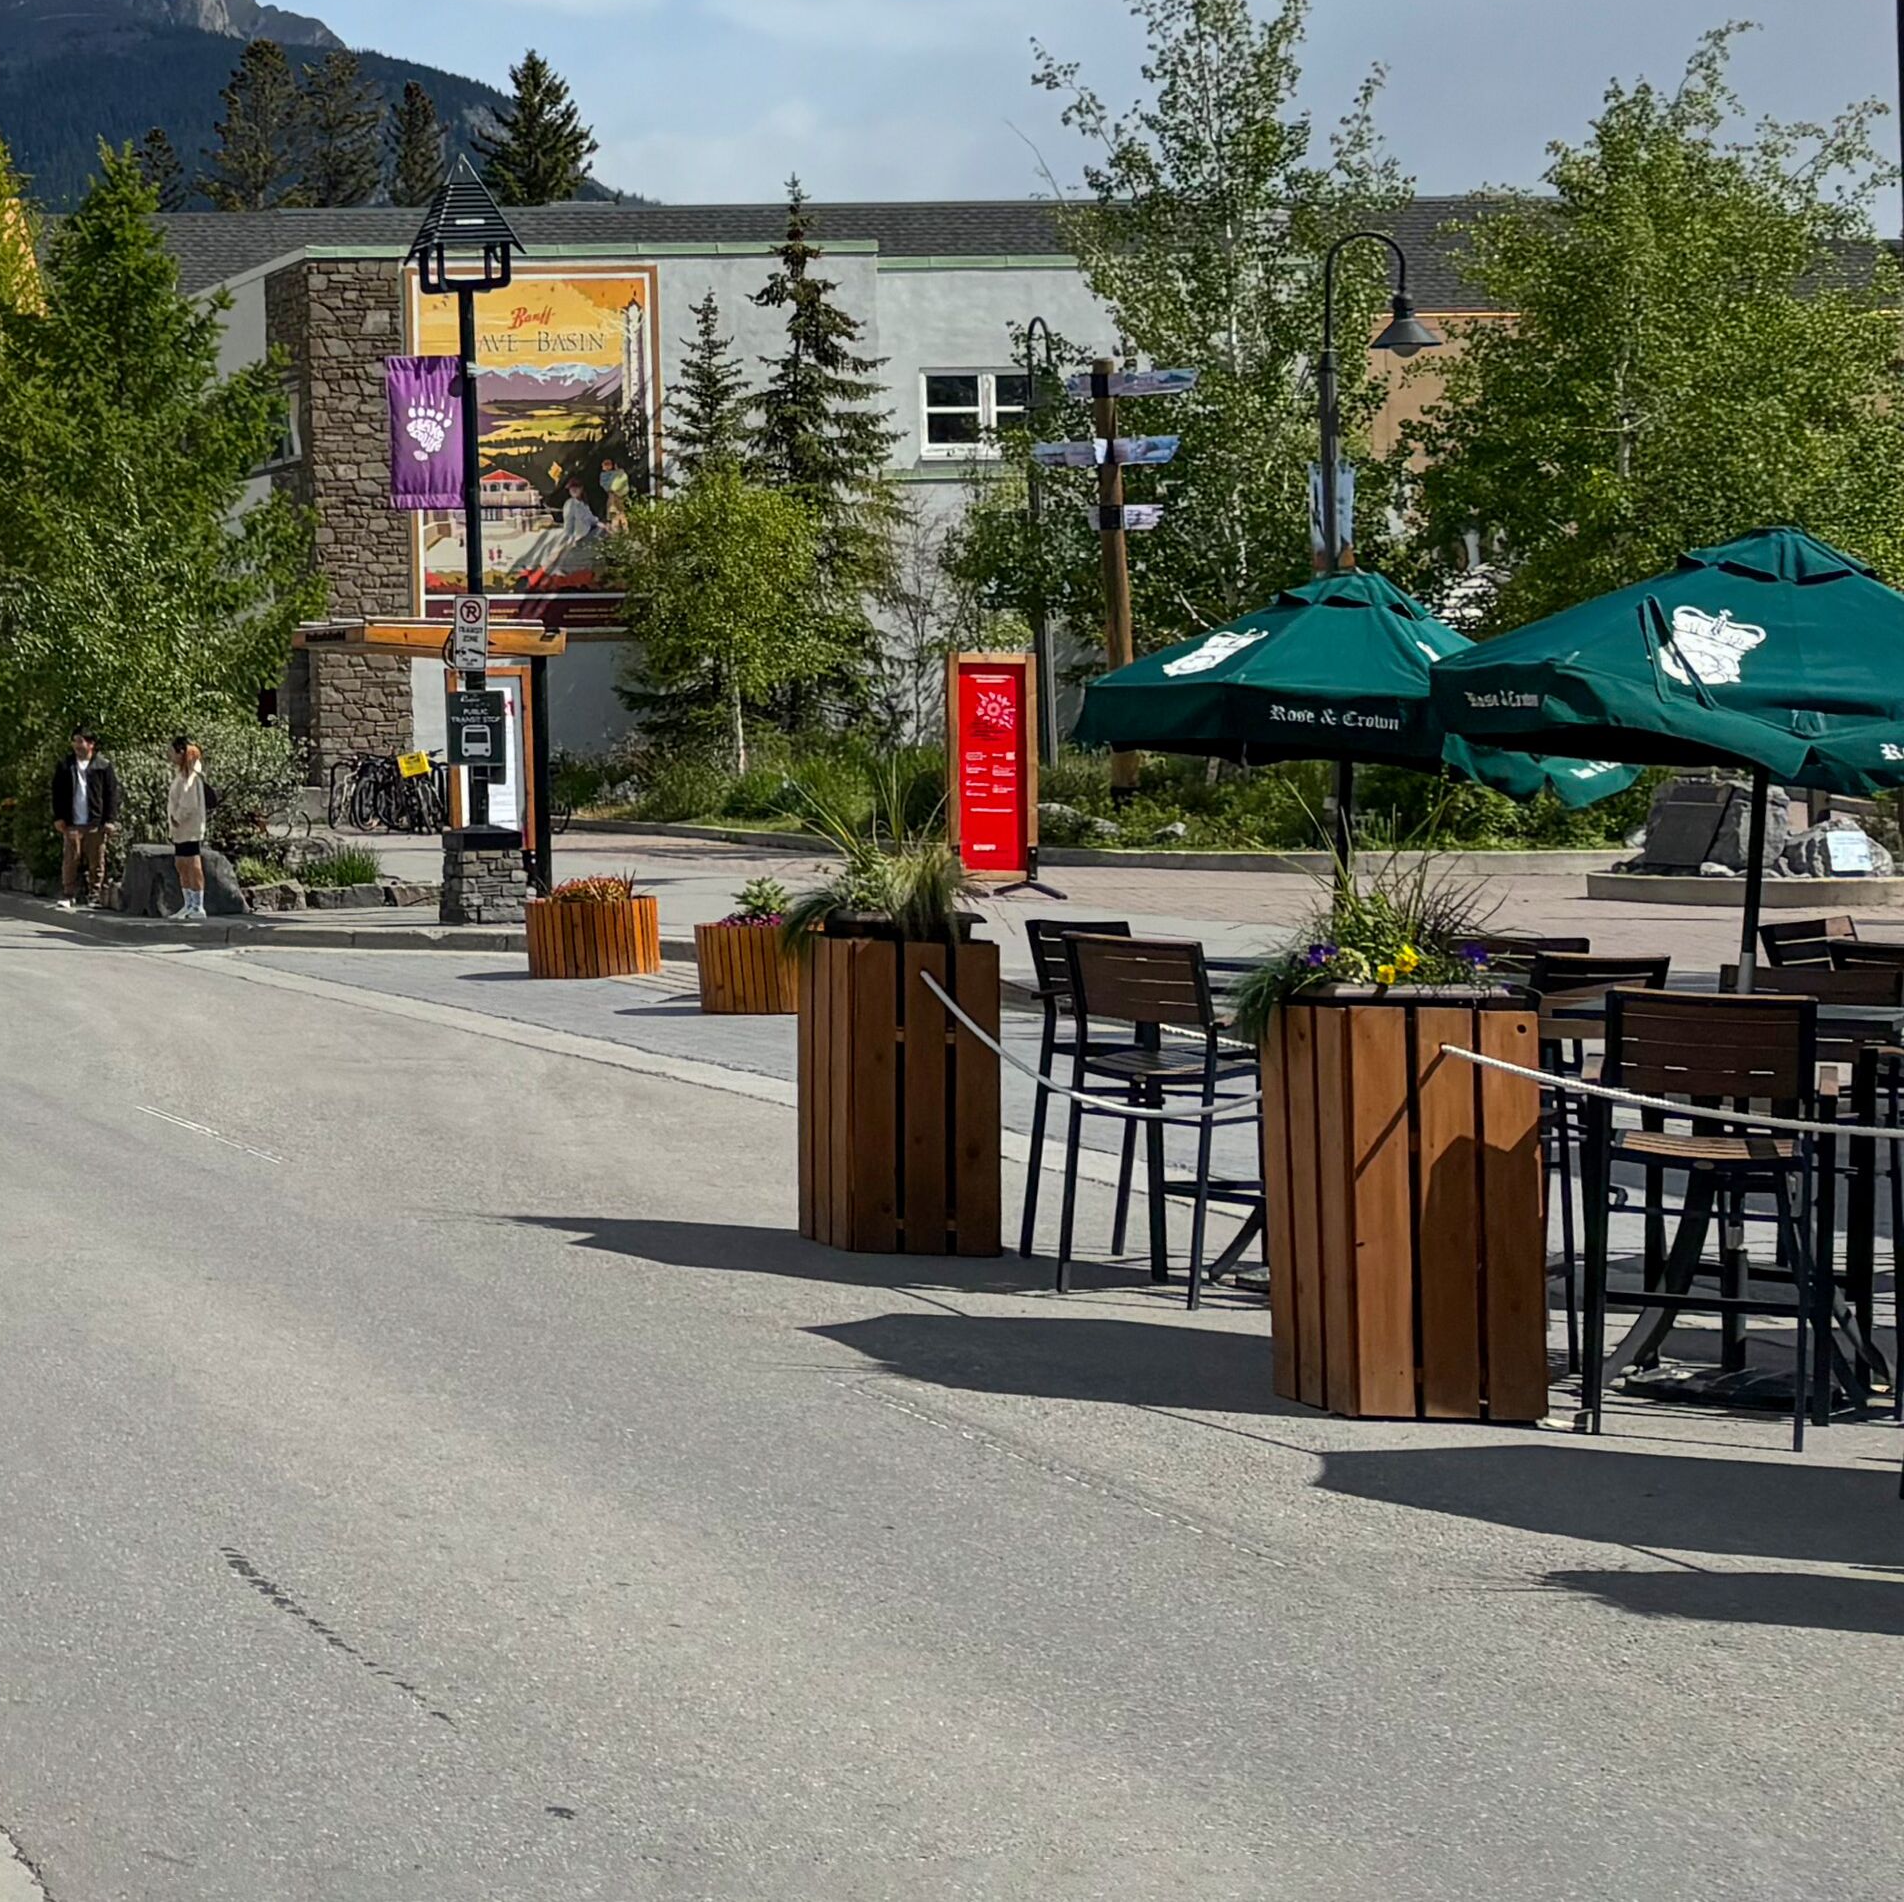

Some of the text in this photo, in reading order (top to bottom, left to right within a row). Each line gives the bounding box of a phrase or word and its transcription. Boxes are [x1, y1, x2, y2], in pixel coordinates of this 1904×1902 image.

[476, 330, 605, 353] AVE BASIN
[450, 716, 481, 724] TRANSIT
[1269, 704, 1399, 731] Rose & Crown
